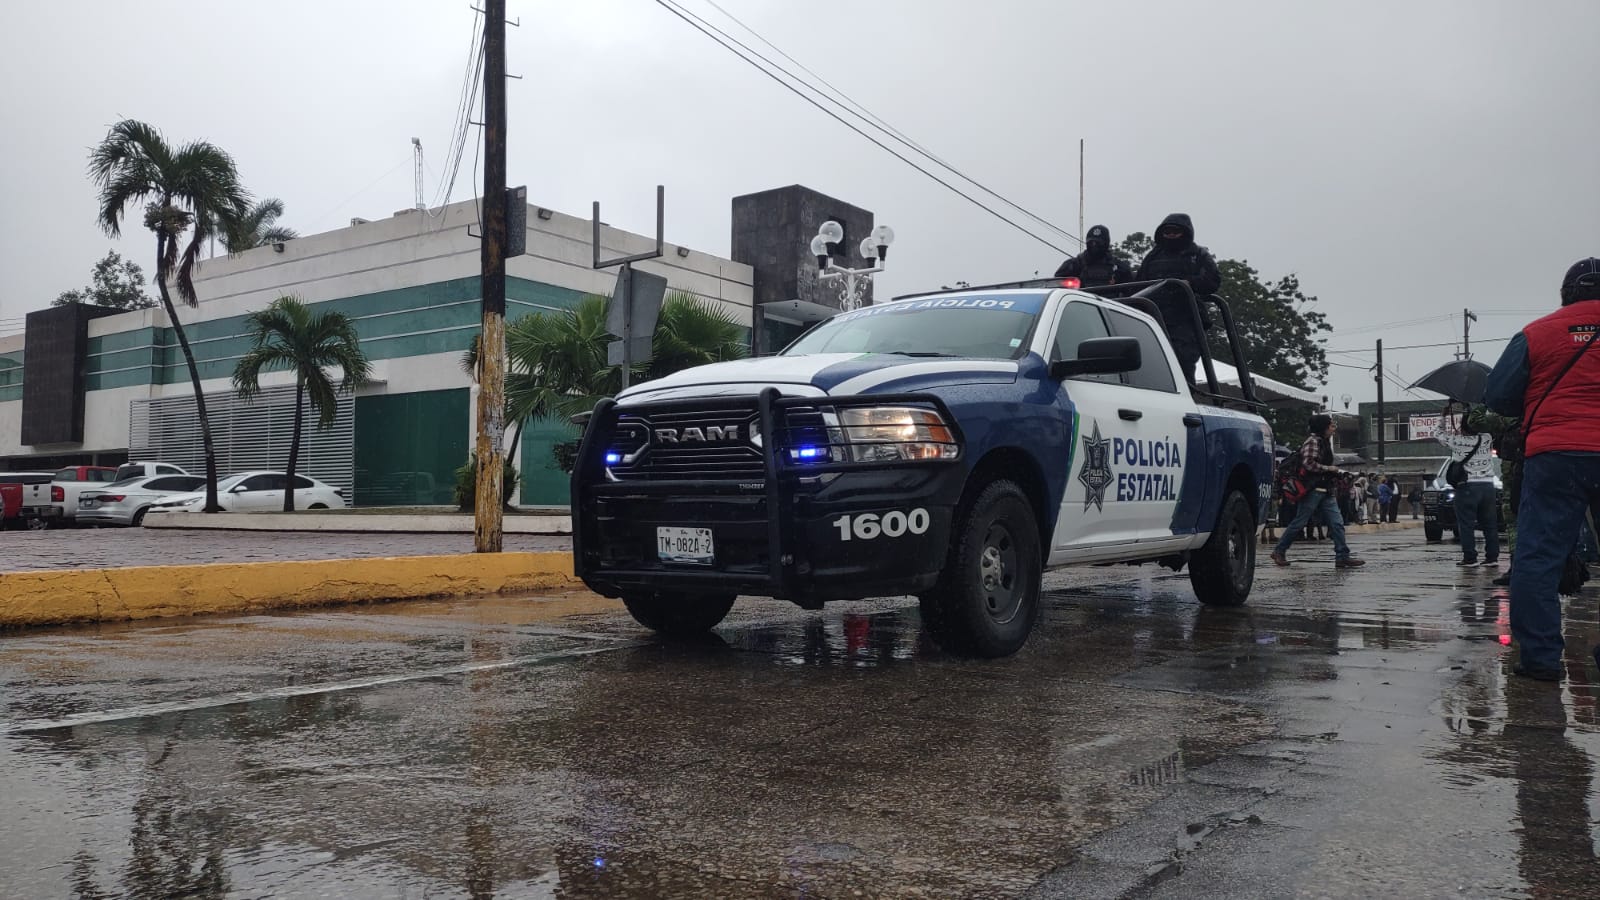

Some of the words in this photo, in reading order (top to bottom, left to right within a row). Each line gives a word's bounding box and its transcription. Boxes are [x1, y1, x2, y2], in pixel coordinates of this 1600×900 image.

[654, 425, 739, 443] RAM
[1113, 436, 1182, 468] POLICÍA
[1117, 473, 1177, 502] ESTATAL
[833, 508, 931, 541] 1600
